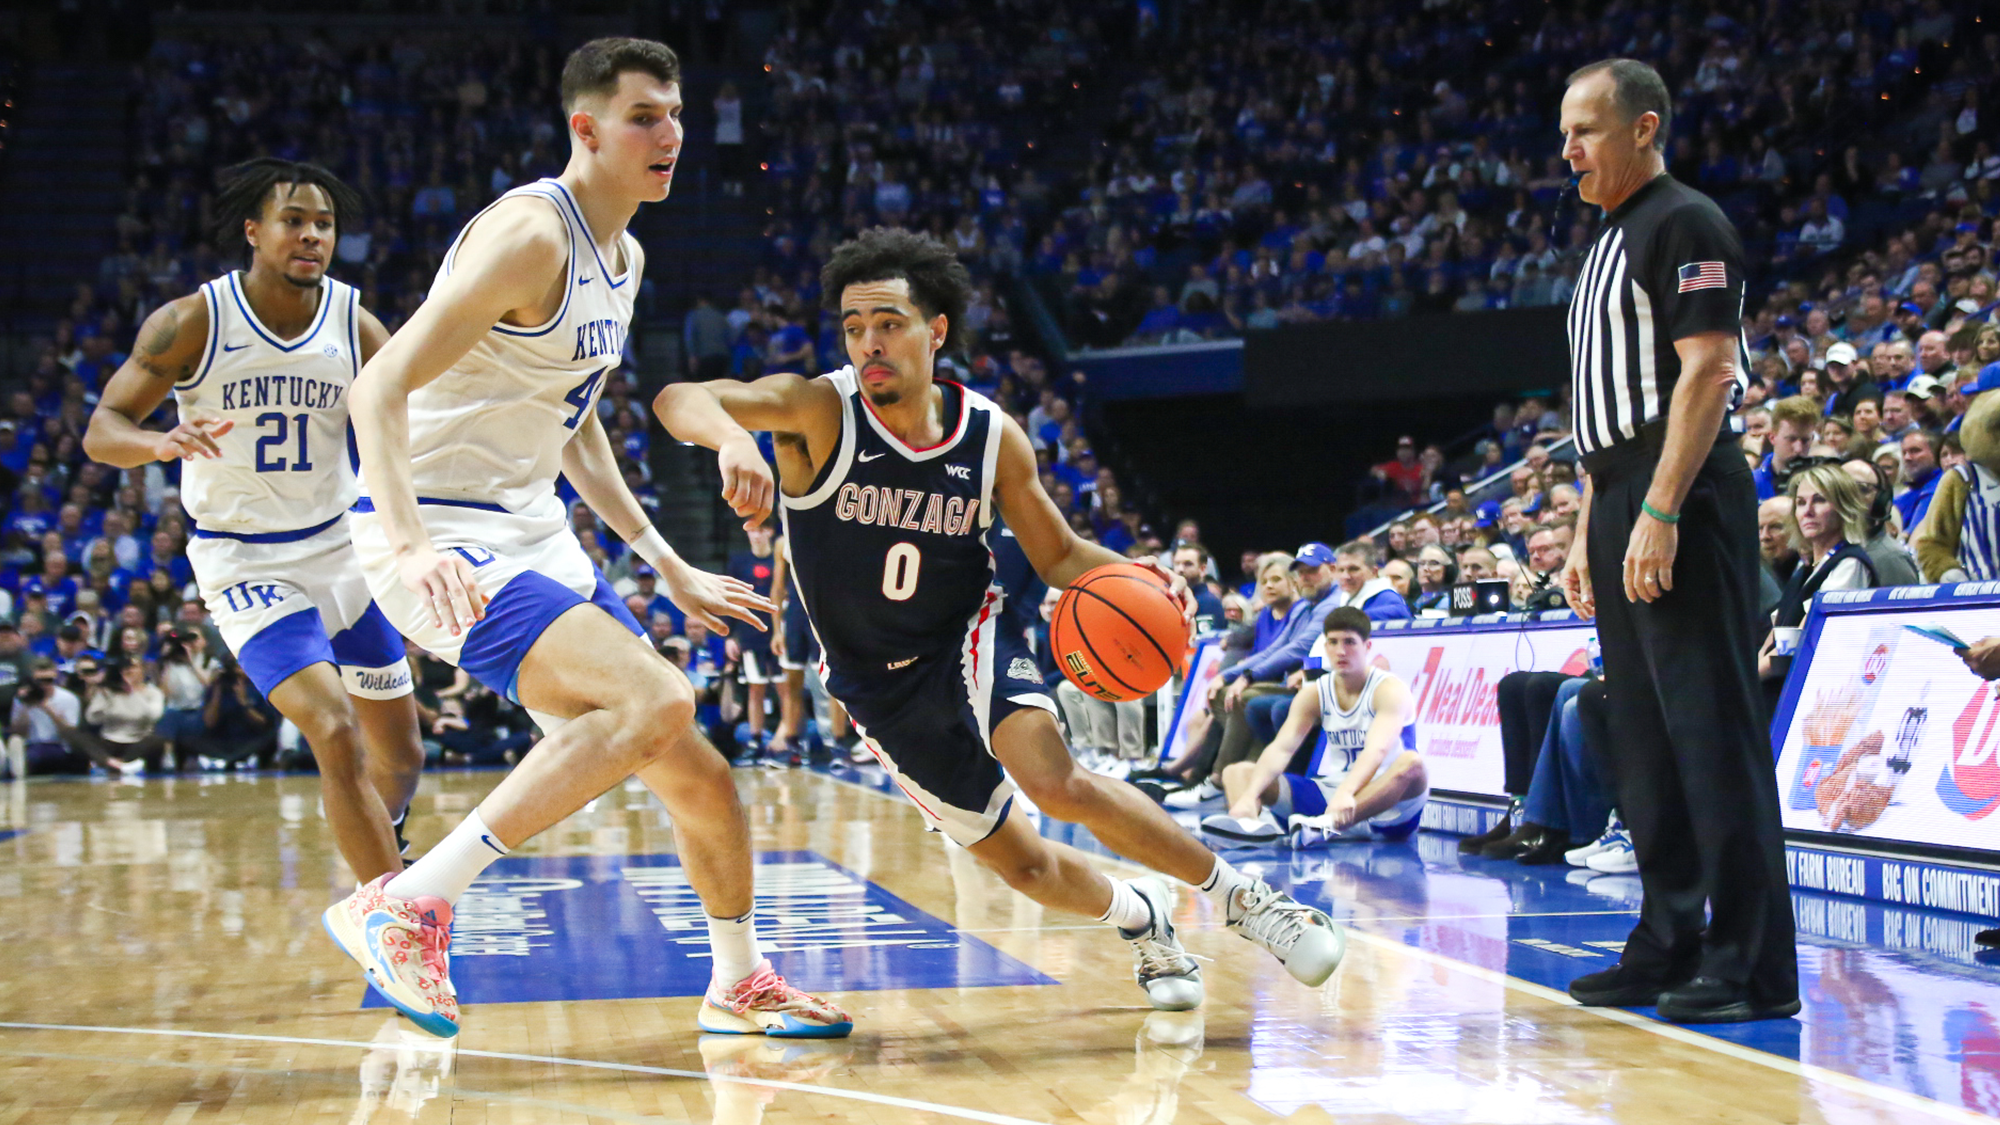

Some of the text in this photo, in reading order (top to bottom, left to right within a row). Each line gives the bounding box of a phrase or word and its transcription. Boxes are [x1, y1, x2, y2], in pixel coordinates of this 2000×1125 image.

[571, 319, 628, 361] KENTU
[223, 376, 343, 410] KENTUCKY
[563, 365, 604, 430] 4
[256, 412, 312, 472] 21
[945, 464, 971, 480] WCC
[835, 483, 980, 536] GONZAGA
[882, 541, 921, 601] 0
[222, 581, 284, 612] UK
[356, 671, 410, 691] Wildcat
[1798, 851, 1825, 890] FARM
[1826, 855, 1866, 896] BUREAU
[1882, 862, 2000, 918] BIG ON COMMITMENT
